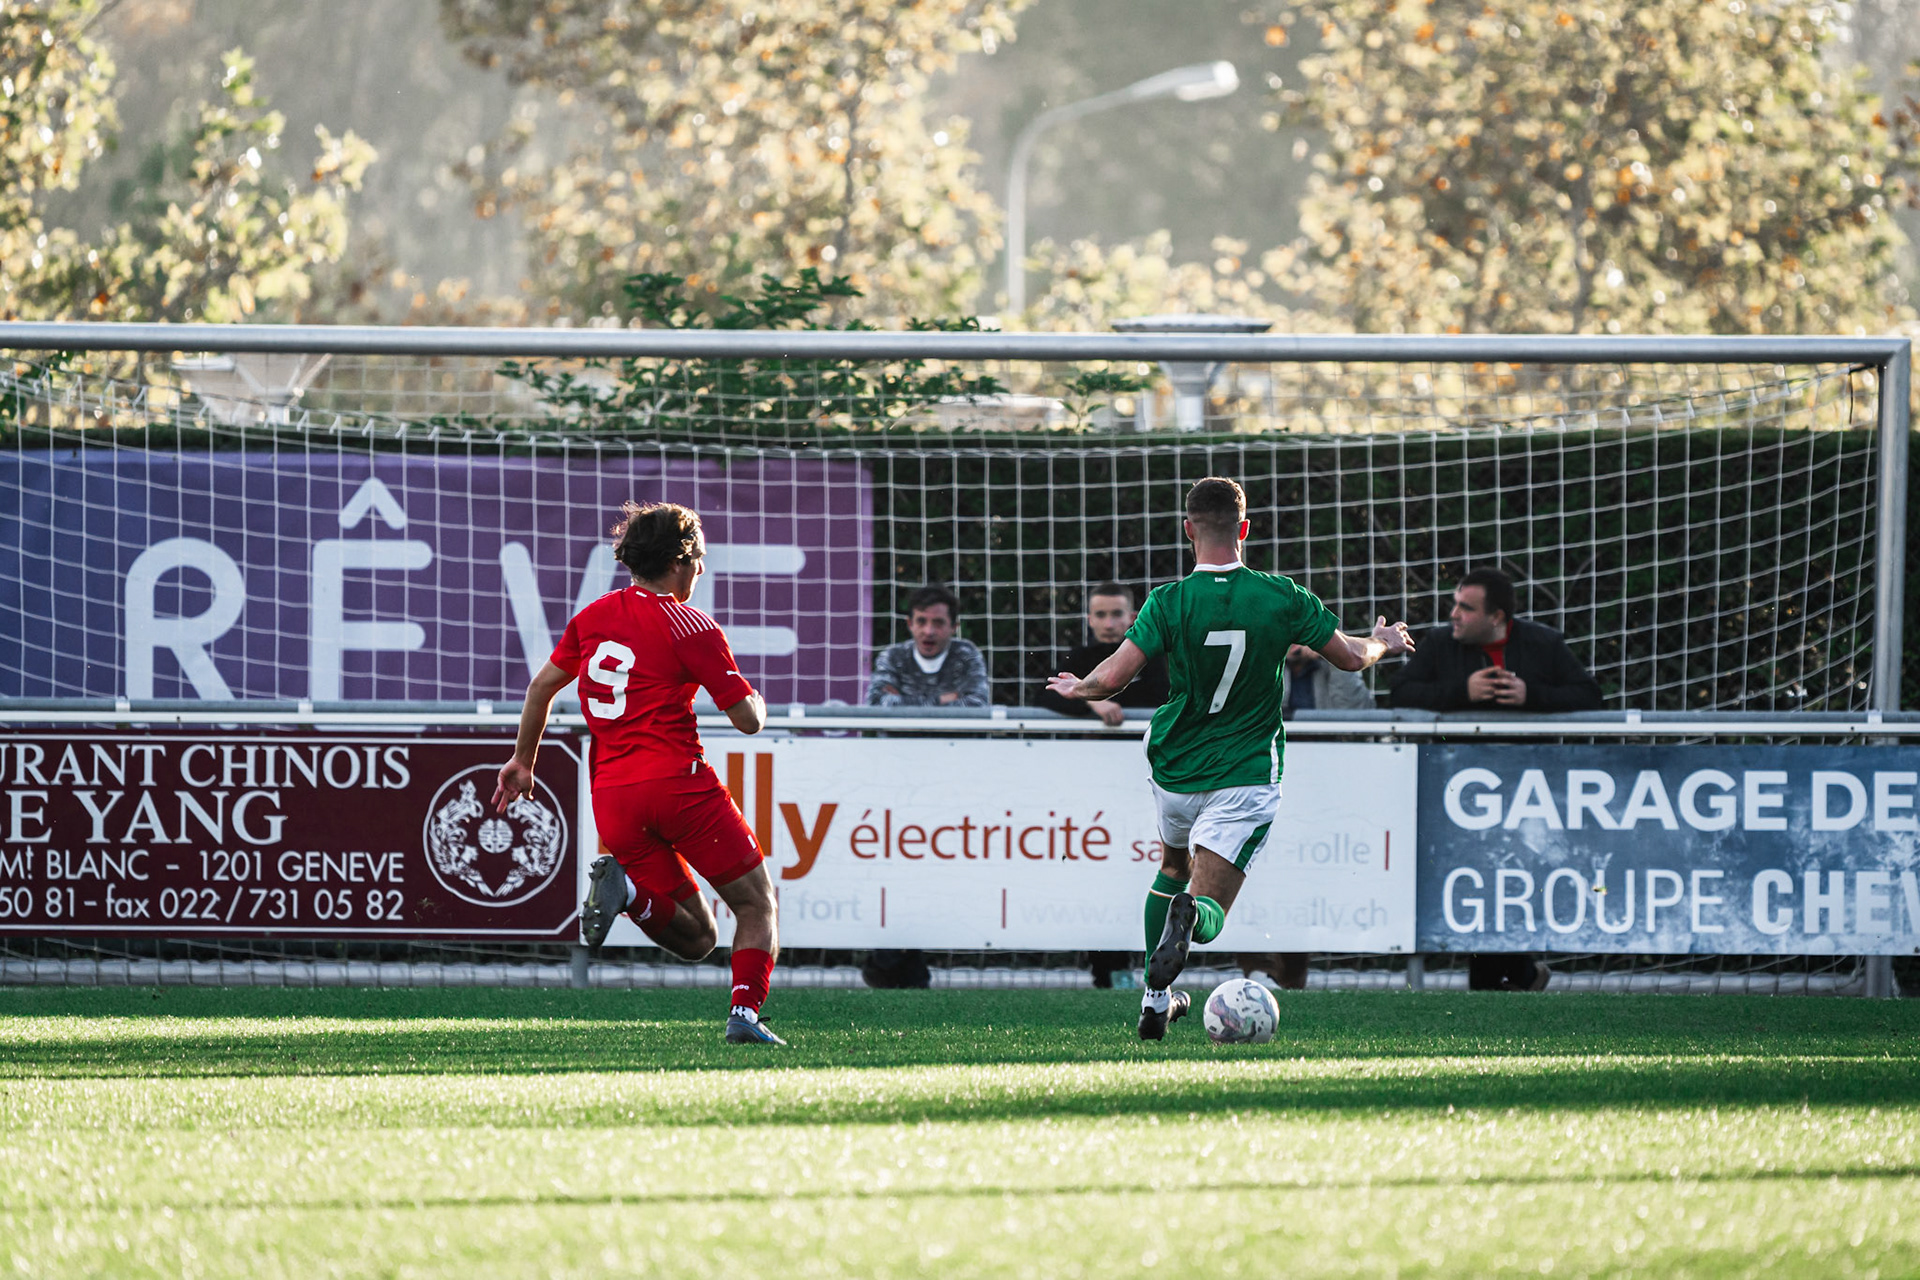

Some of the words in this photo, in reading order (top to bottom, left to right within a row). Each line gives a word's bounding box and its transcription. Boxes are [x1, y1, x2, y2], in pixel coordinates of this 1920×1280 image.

[587, 640, 636, 720] 9
[1203, 630, 1246, 714] 7
[179, 745, 411, 790] CHINOIS
[72, 788, 288, 846] YANG
[1443, 767, 1788, 832] GARAGE
[1812, 770, 1918, 831] DE
[850, 808, 1111, 861] électricité
[46, 849, 150, 881] BLANC
[200, 851, 262, 882] 1201
[277, 852, 404, 883] GENEVE
[45, 886, 75, 918] 81
[105, 883, 150, 918] fax
[314, 888, 352, 920] 05
[365, 889, 404, 920] 82
[1442, 866, 1725, 934] GROUPE
